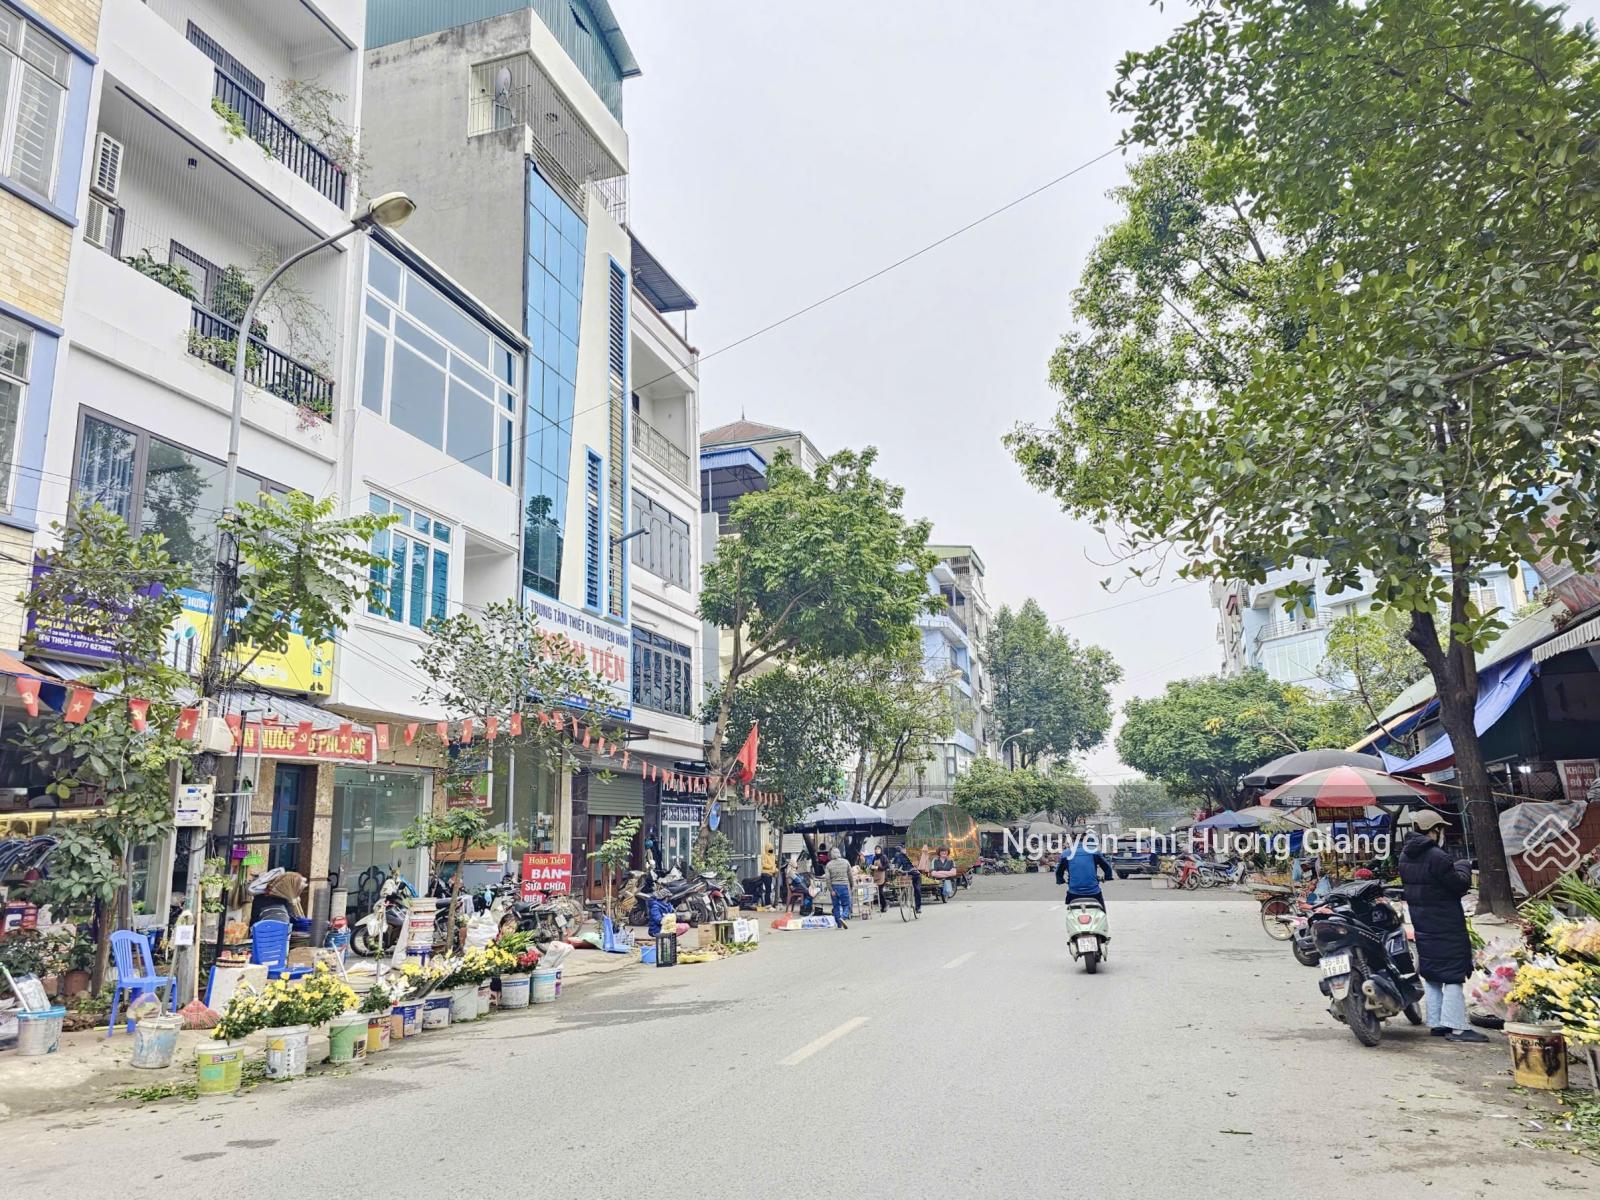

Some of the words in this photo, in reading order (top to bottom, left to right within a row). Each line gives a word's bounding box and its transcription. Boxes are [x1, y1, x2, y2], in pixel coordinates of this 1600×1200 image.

[530, 599, 552, 620] TRUNG
[554, 607, 568, 626] TÂM
[569, 614, 585, 633] THIẾT
[586, 621, 594, 639] BỊ
[590, 645, 625, 683] TIẾN
[1565, 764, 1595, 774] KHÔNG
[531, 866, 562, 879] BÁN
[525, 879, 542, 891] SỬA
[543, 880, 566, 891] CHỮA
